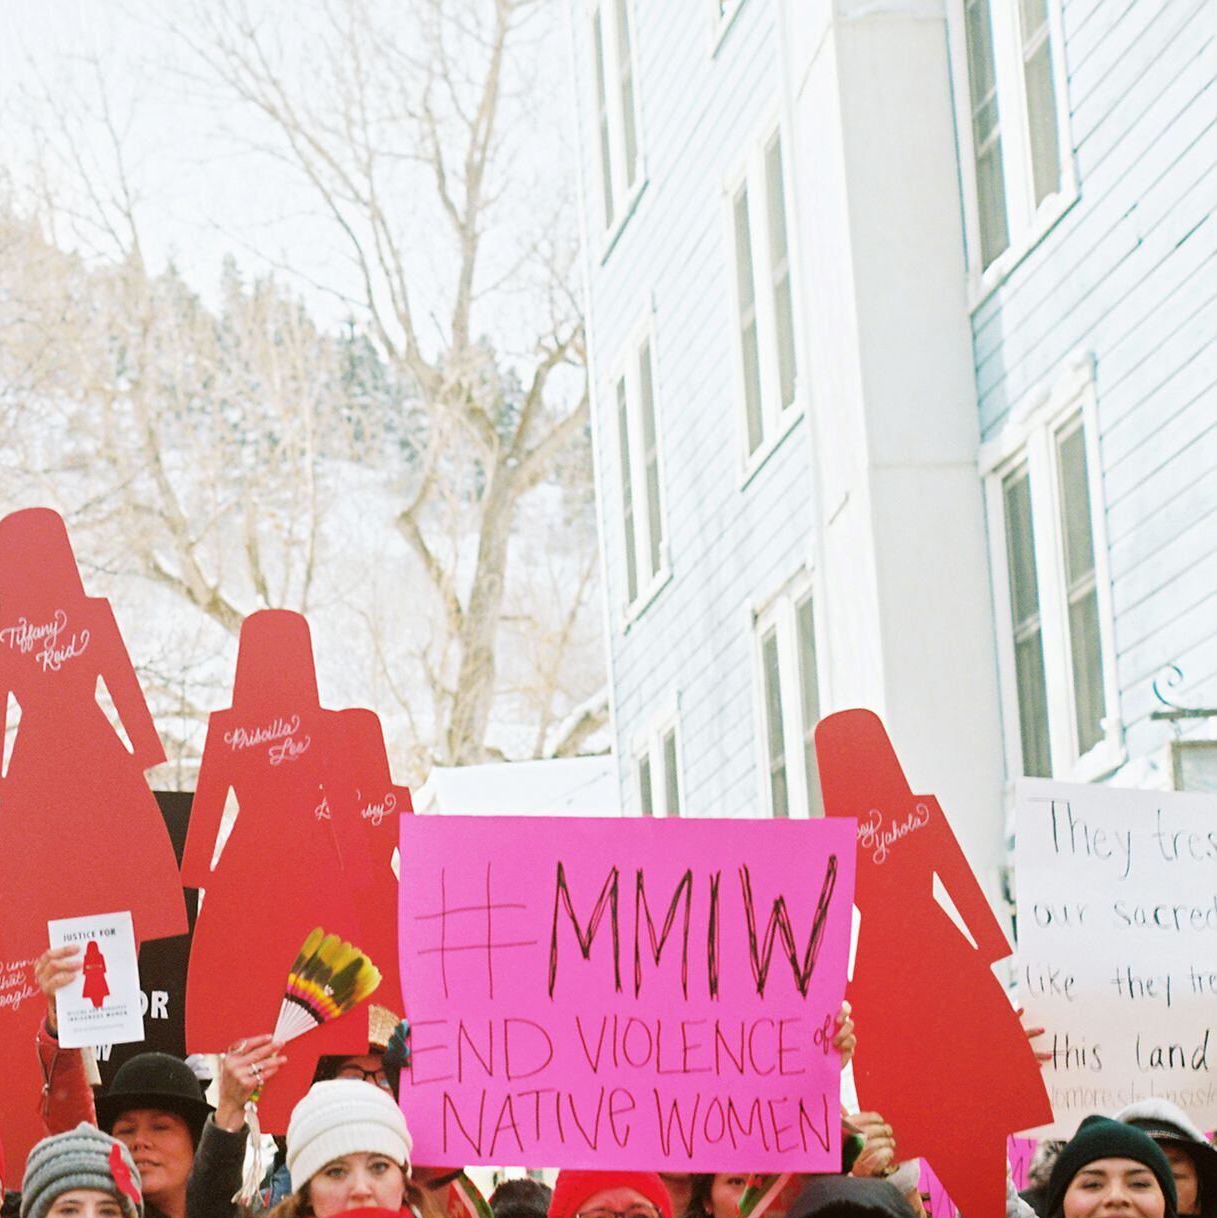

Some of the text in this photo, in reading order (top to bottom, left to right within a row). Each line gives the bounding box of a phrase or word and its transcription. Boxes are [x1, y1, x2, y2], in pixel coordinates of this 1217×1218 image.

[0, 609, 67, 654] Tiffany
[224, 714, 300, 751] Priscilla
[1028, 798, 1131, 880] They
[414, 854, 837, 1000] #MMIW
[1034, 901, 1087, 929] our
[1026, 964, 1078, 1001] like
[1110, 965, 1171, 1007] they
[411, 1018, 554, 1085] END
[577, 1014, 806, 1075] VIOLENCE
[1050, 1028, 1210, 1072] this land
[654, 1087, 832, 1159] WOMEN
